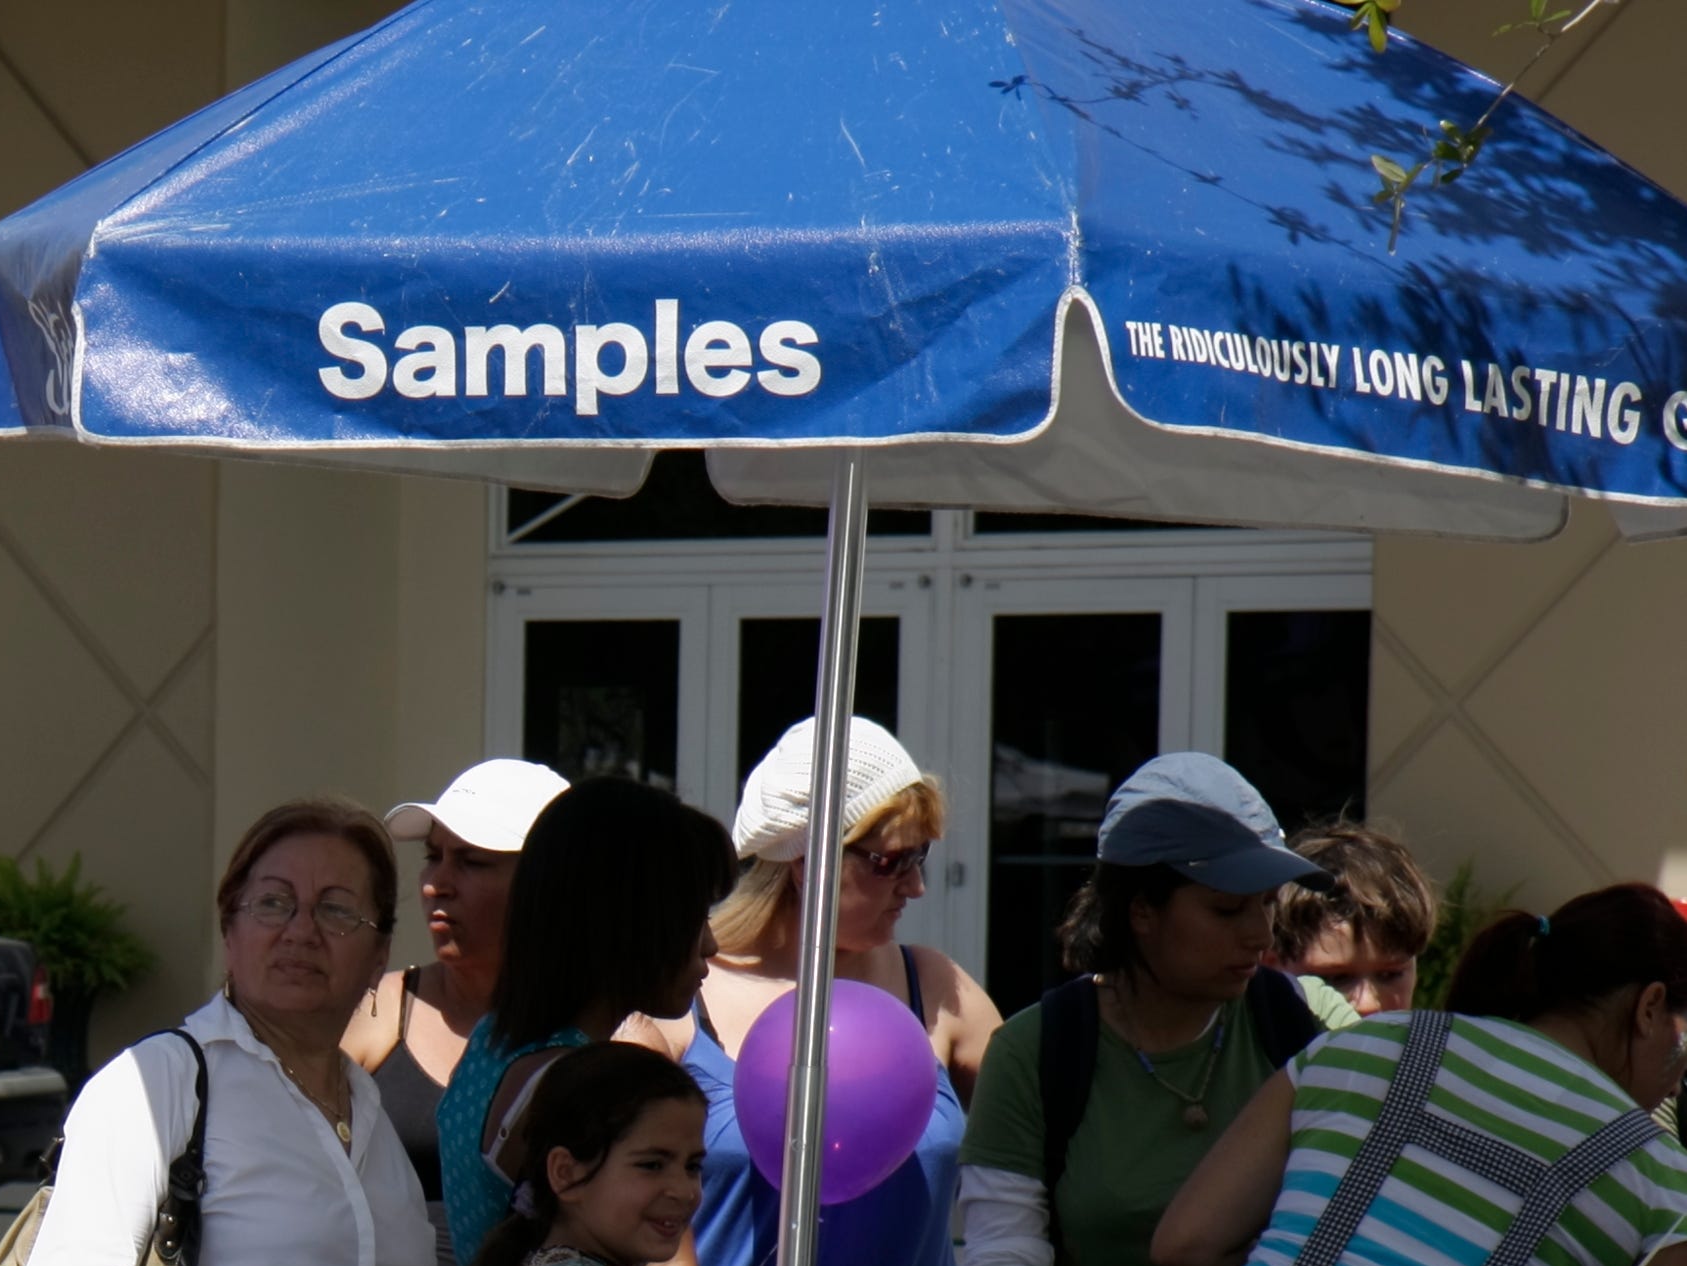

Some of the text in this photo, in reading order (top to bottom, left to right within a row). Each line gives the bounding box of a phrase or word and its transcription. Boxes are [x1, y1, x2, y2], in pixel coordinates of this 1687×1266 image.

[316, 298, 822, 417] Samples
[1126, 320, 1165, 359] THE
[1170, 324, 1340, 389] RIDICULOUSLY
[1353, 346, 1449, 406] LONG
[1461, 359, 1643, 446] LASTING
